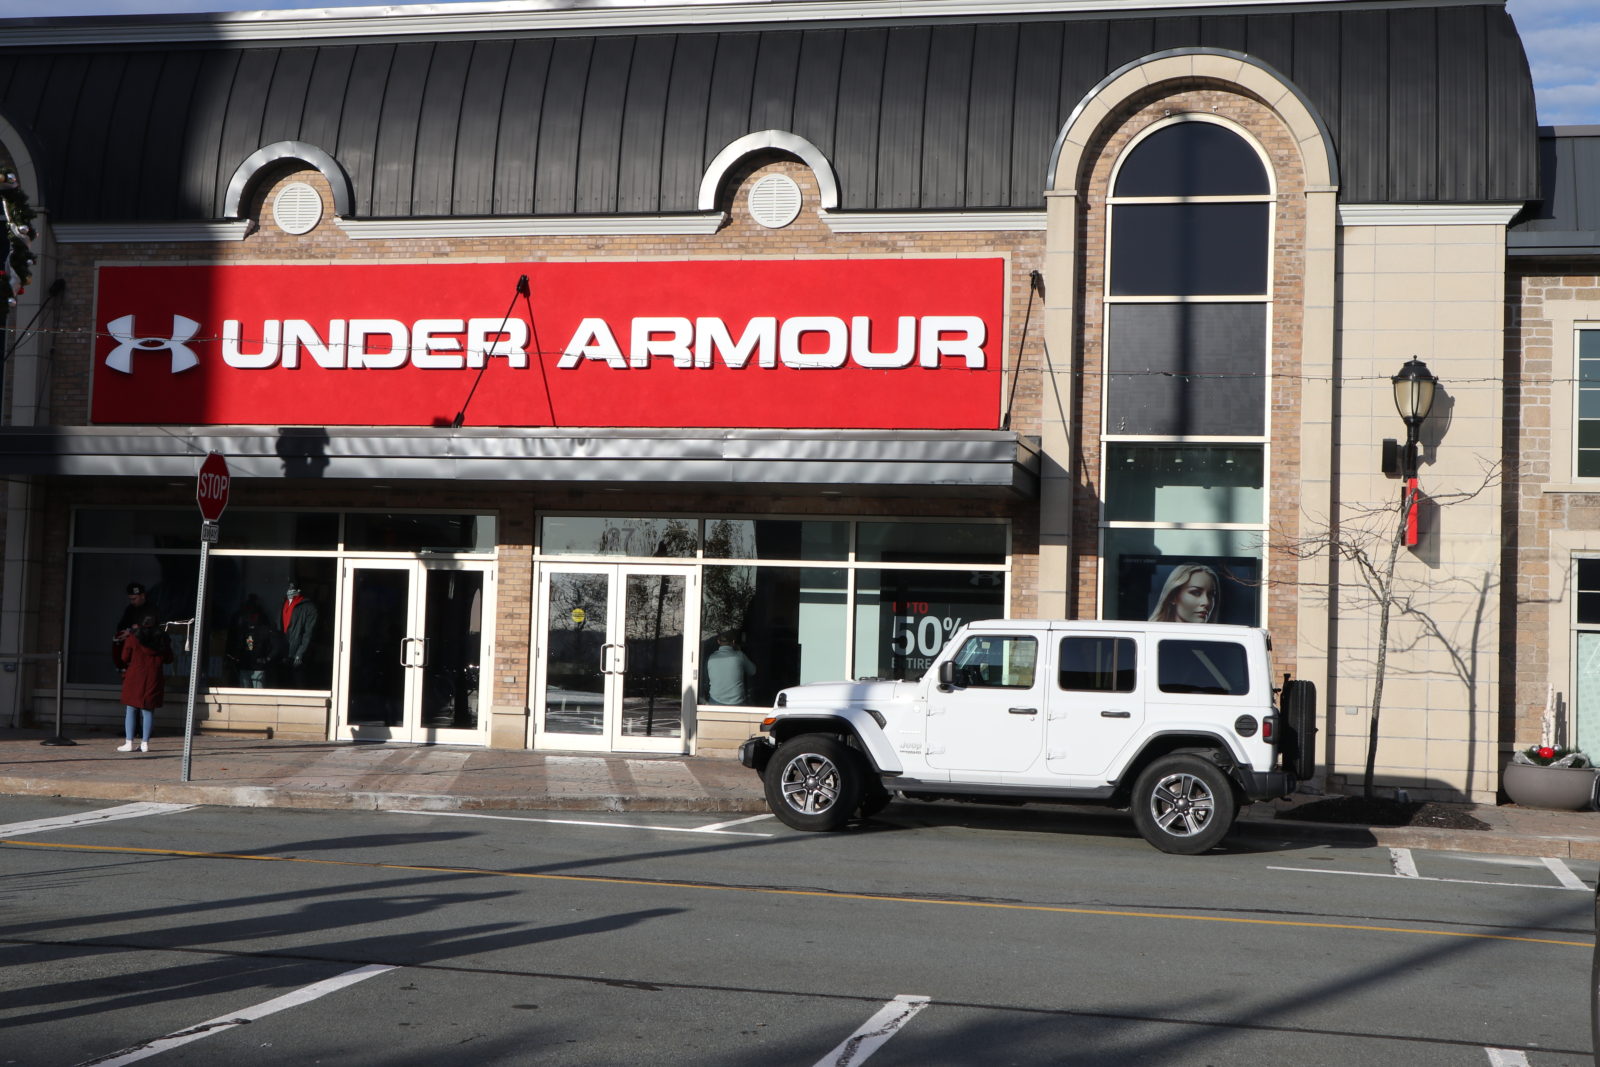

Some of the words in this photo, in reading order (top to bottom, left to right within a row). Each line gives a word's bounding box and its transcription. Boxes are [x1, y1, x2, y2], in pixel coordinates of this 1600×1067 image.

[222, 318, 530, 370] UNDER
[556, 316, 988, 370] ARMOUR
[200, 473, 228, 500] STOP
[912, 601, 929, 614] TO
[892, 615, 961, 657] 50%
[891, 657, 932, 669] TIRE
[899, 742, 922, 750] Jeep
